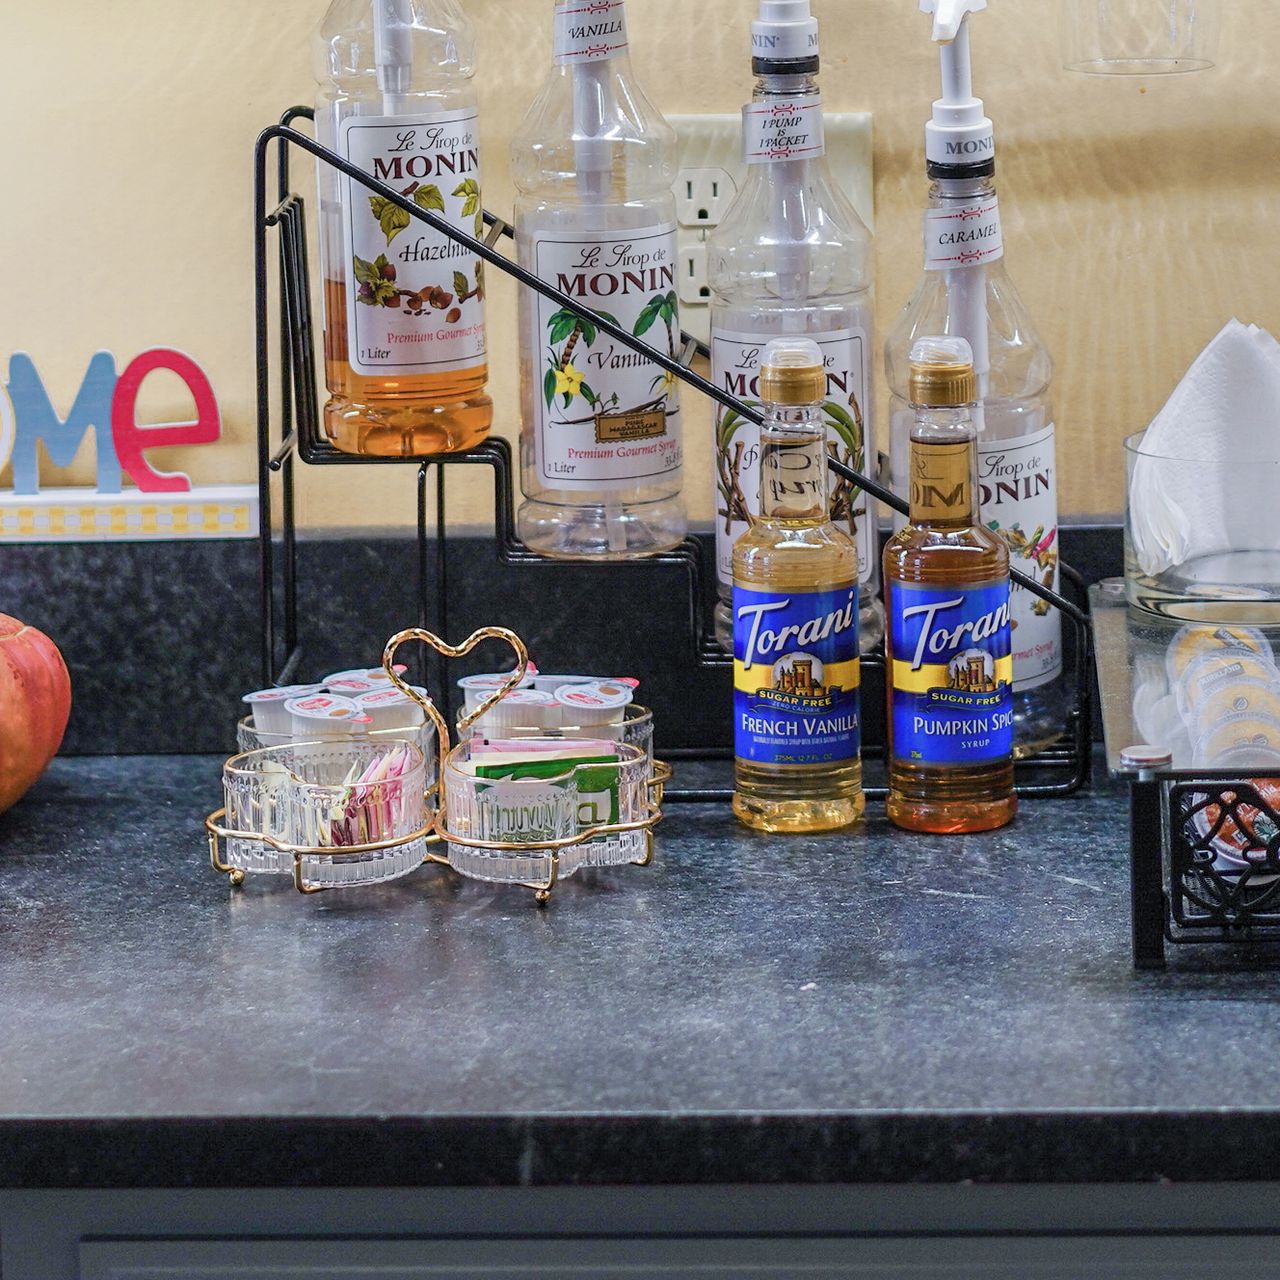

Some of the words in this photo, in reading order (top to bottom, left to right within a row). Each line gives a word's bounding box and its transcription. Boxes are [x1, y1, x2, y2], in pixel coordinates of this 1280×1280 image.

[568, 20, 623, 39] VANILLA
[767, 116, 802, 128] PUMP
[387, 129, 416, 152] Le
[419, 127, 460, 152] Sirop
[462, 132, 472, 146] de
[765, 134, 808, 147] PACKET
[777, 128, 786, 137] IS
[945, 136, 994, 155] MONI
[372, 147, 479, 180] MONIN
[938, 222, 998, 245] CARAMEL
[571, 246, 601, 268] Le
[605, 244, 650, 269] Sirop
[652, 248, 666, 261] de
[556, 261, 674, 297] MONIN
[387, 331, 433, 344] Premium
[367, 347, 391, 359] Liter
[735, 348, 759, 369] Le
[567, 448, 614, 459] Premium
[616, 442, 657, 458] Gourmet
[554, 462, 577, 473] Liter
[979, 455, 1024, 479] Sirop
[1027, 456, 1041, 470] de
[738, 591, 855, 670] Torani
[759, 691, 798, 705] SUGAR
[803, 697, 832, 707] FREE
[931, 692, 972, 705] SUGAR
[976, 694, 1001, 706] FREE
[741, 713, 798, 736] FRENCH
[803, 713, 858, 735] VANILLA
[913, 716, 989, 736] PUMPKIN
[991, 708, 1014, 731] SPIC
[961, 738, 991, 749] SYRUP
